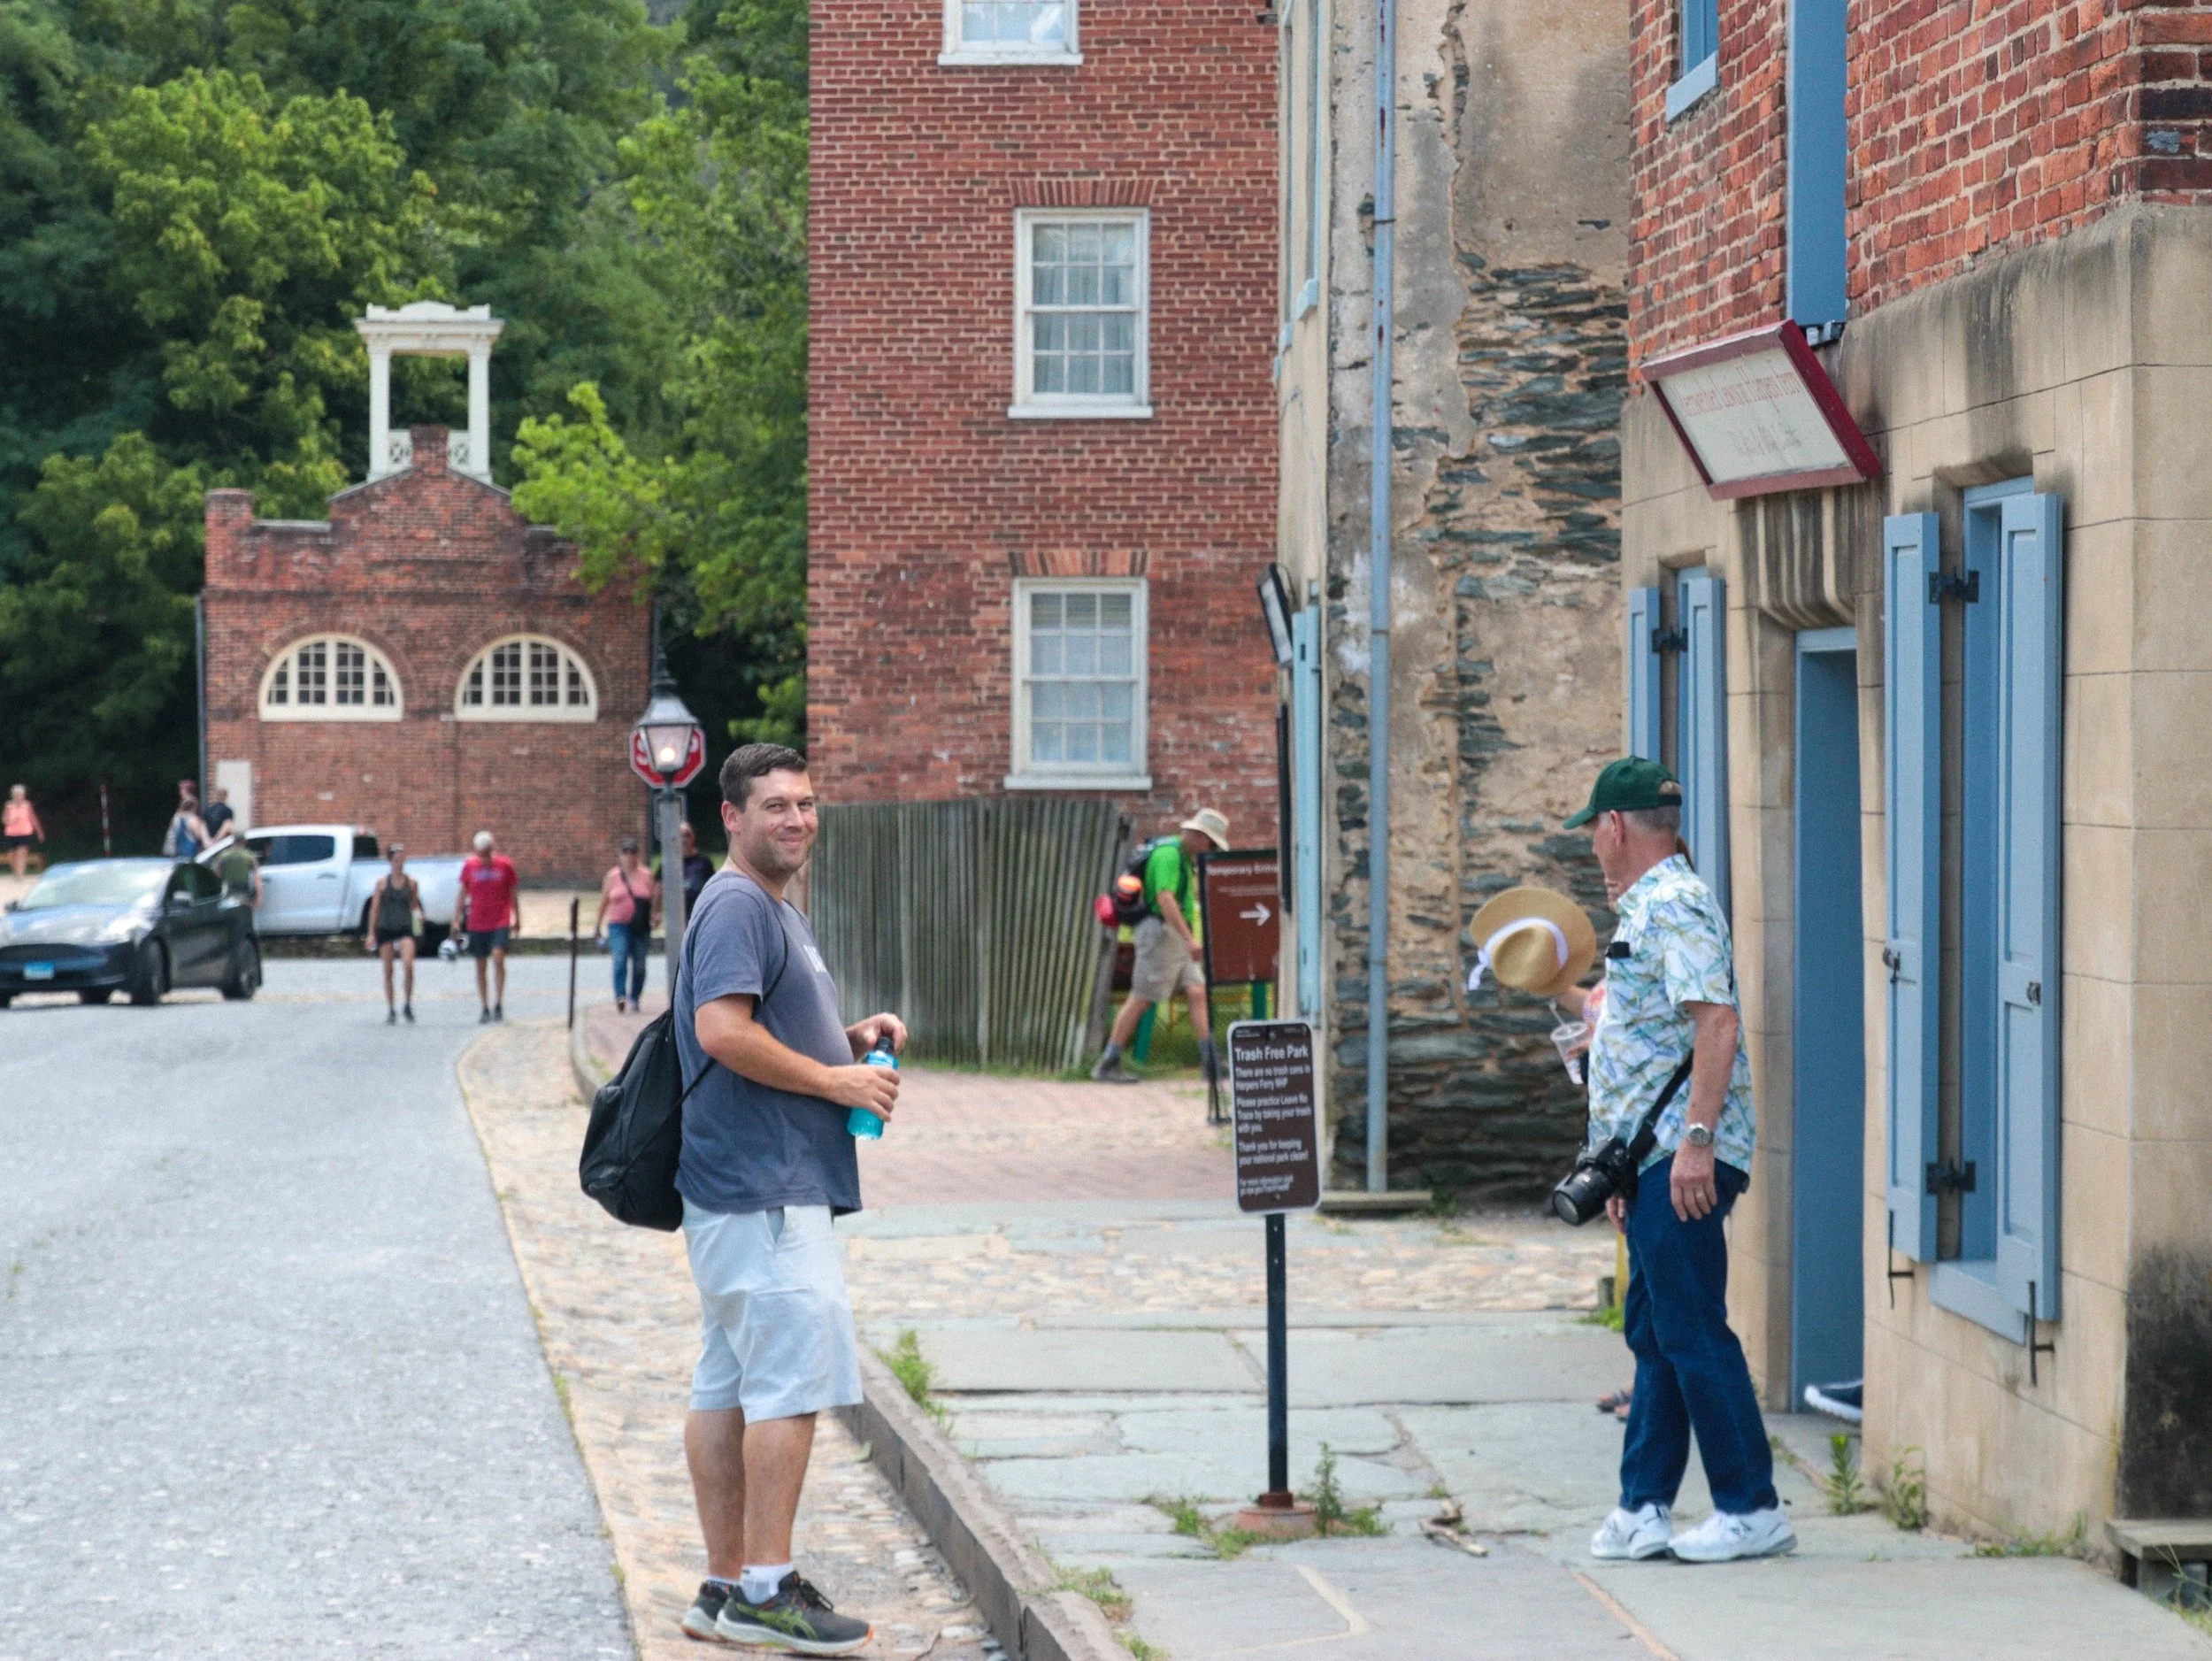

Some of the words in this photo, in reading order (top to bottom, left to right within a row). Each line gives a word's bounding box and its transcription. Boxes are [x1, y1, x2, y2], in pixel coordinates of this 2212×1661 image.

[1234, 1047, 1263, 1062] Trash
[1263, 1045, 1286, 1060] Free
[1286, 1044, 1309, 1058] Park
